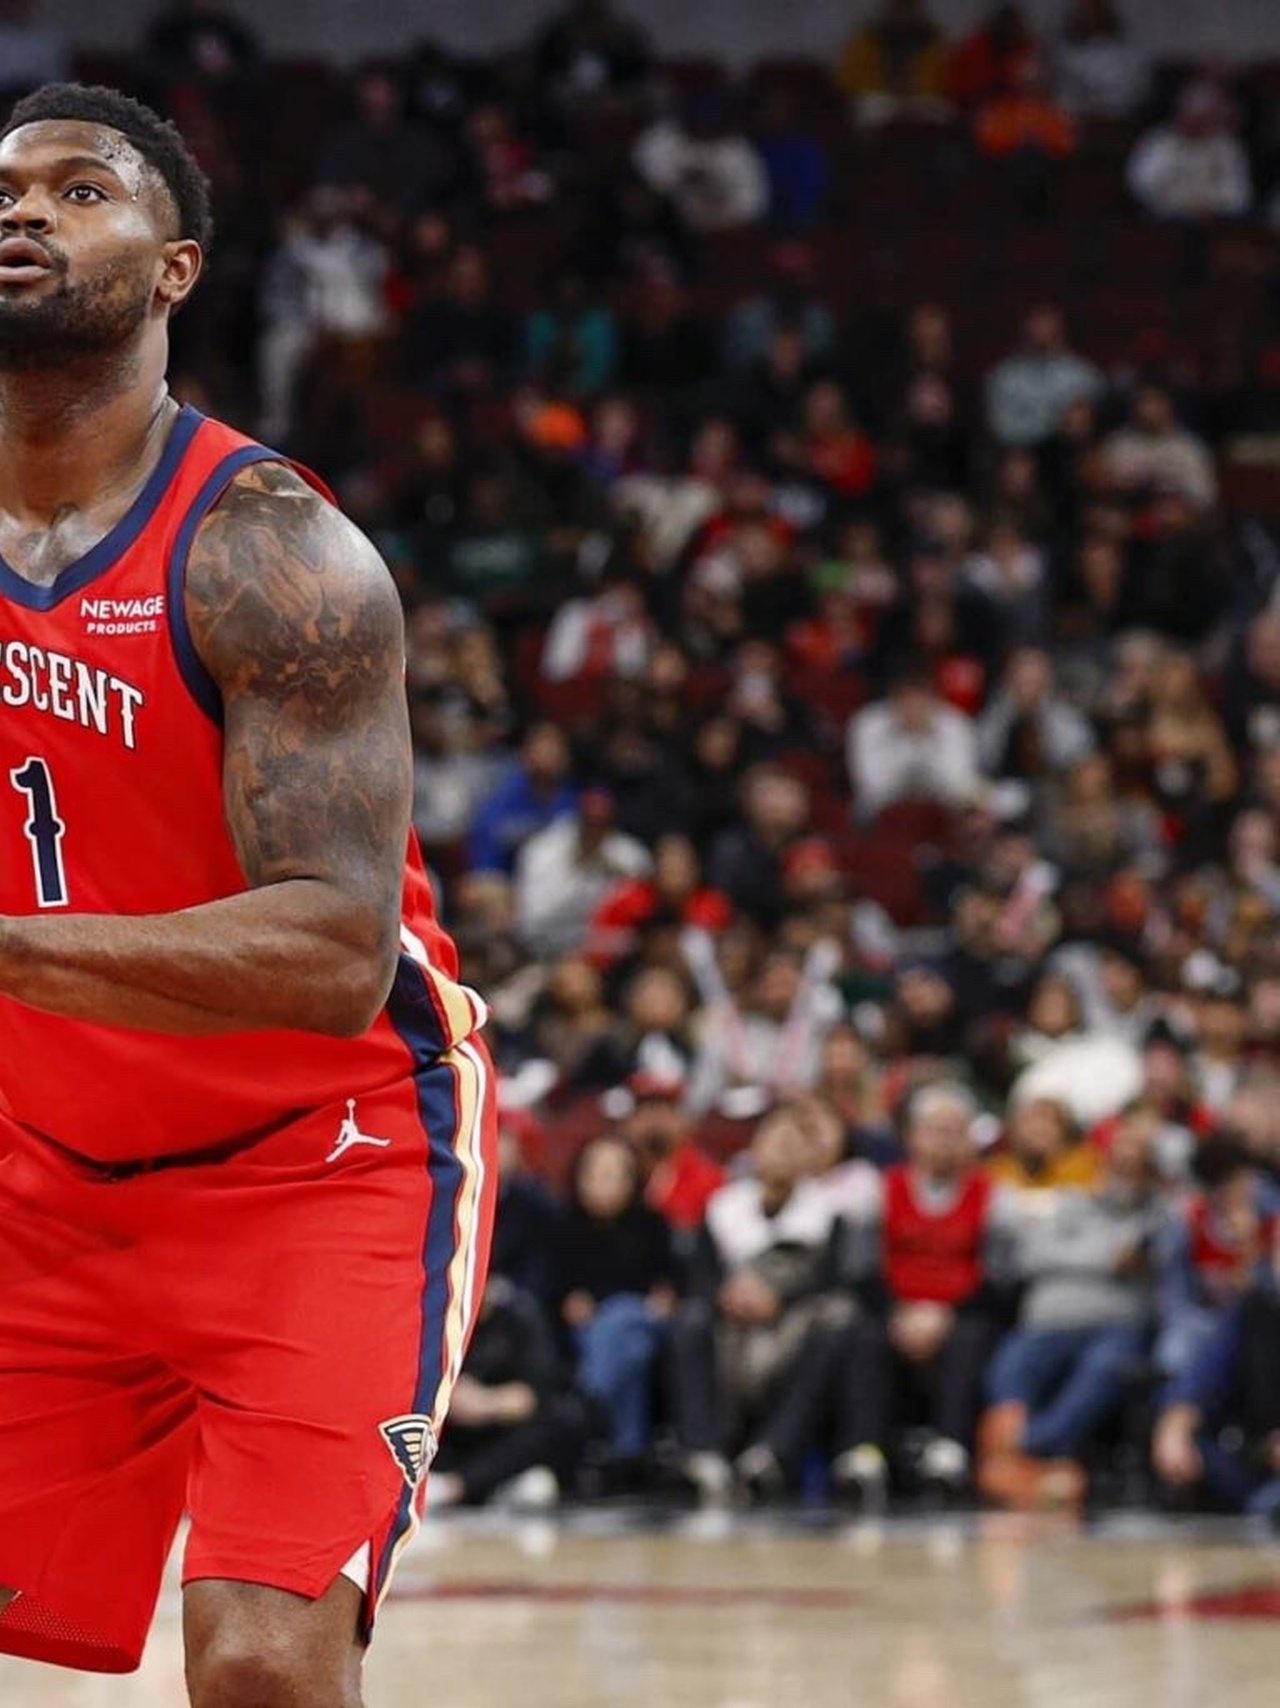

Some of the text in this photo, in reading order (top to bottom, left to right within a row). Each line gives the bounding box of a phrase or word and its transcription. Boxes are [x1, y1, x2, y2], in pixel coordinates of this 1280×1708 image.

[80, 595, 164, 619] NEWAGE
[86, 620, 156, 635] PRODUCTS
[9, 756, 69, 908] 1
